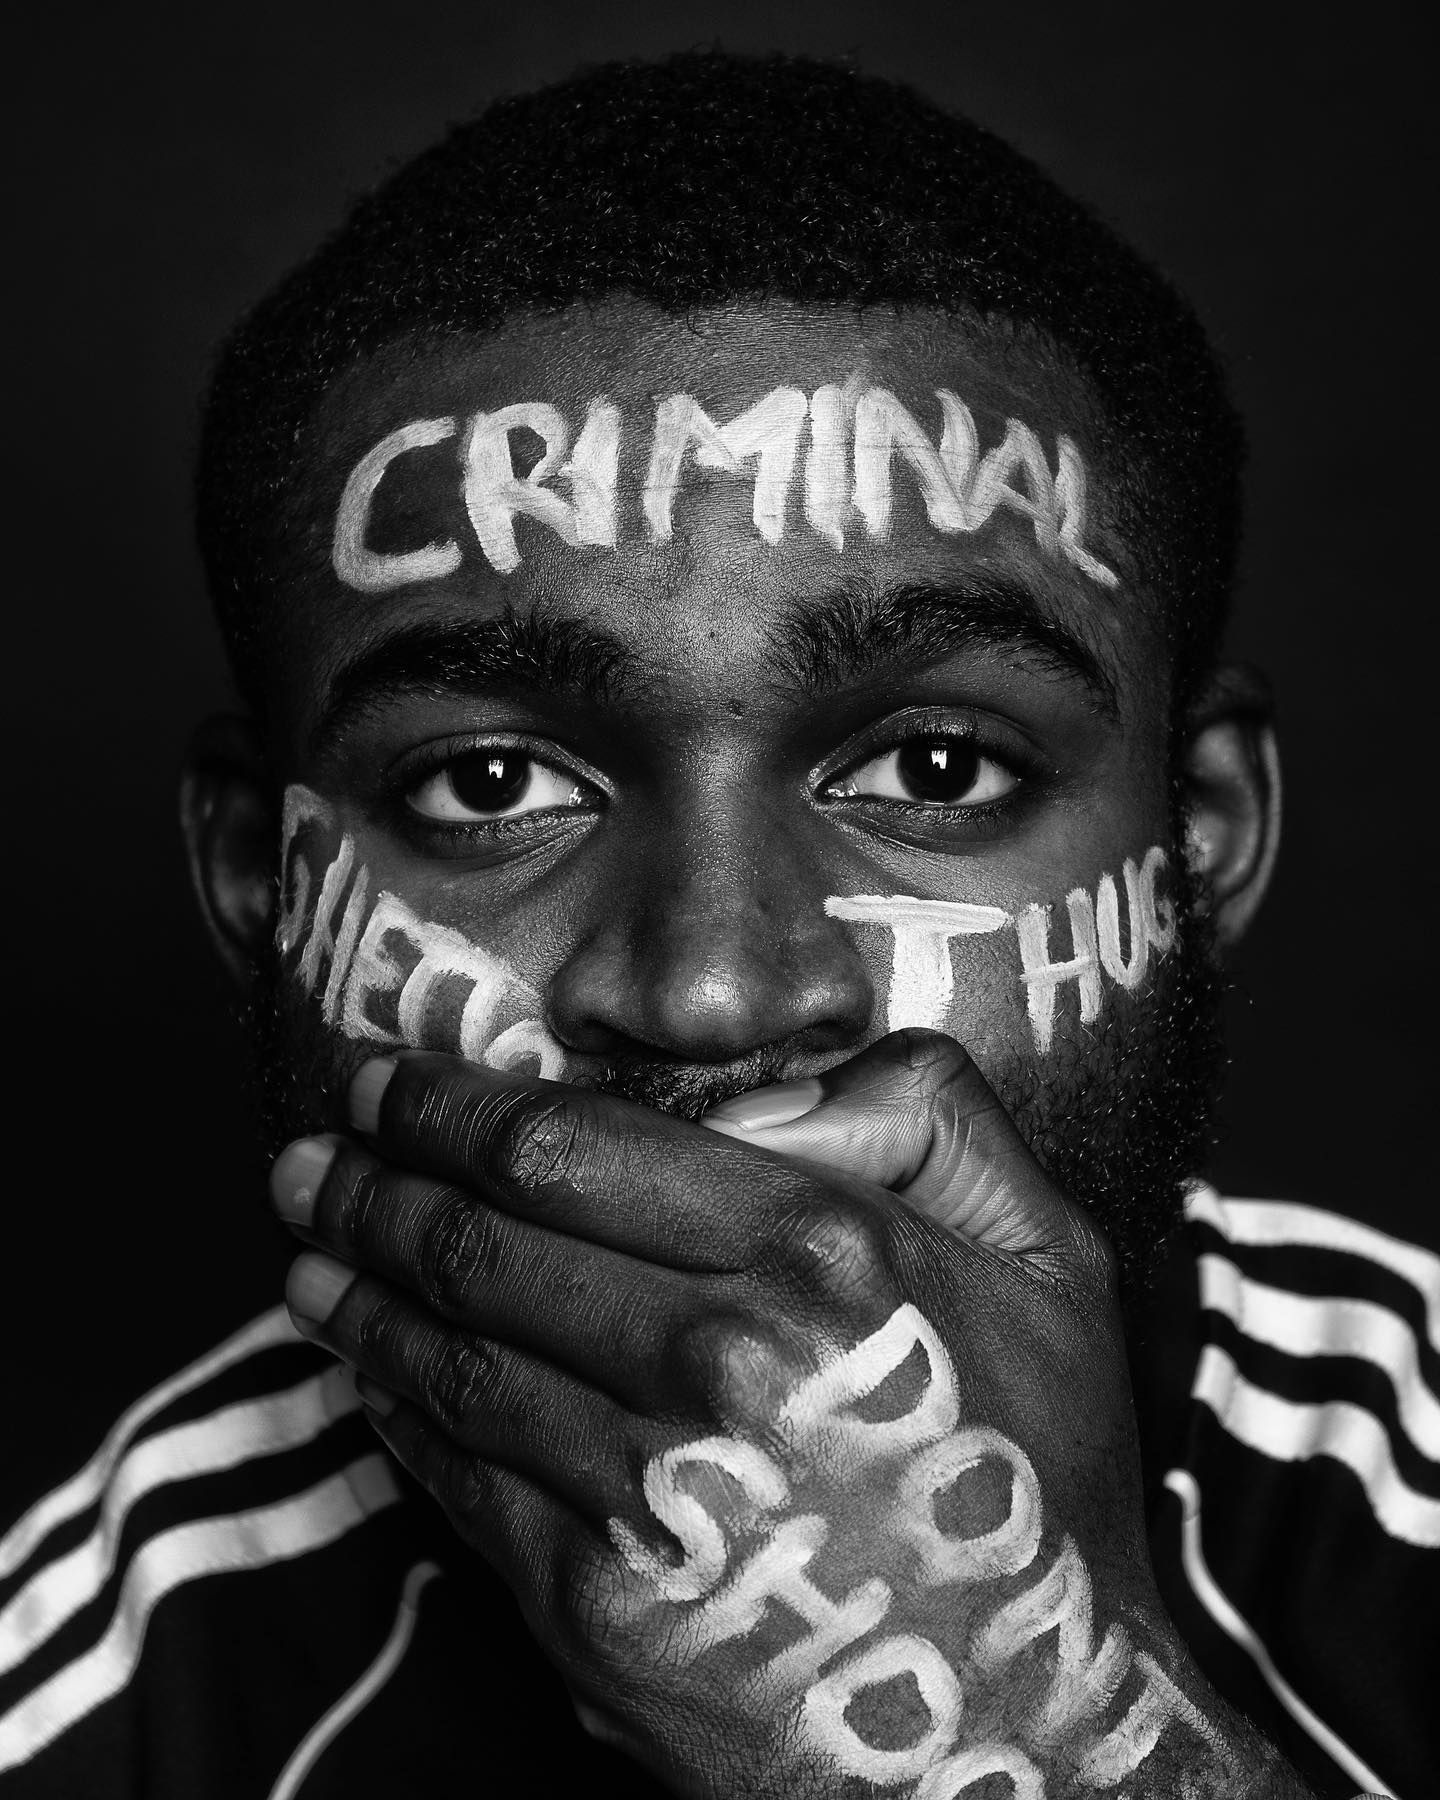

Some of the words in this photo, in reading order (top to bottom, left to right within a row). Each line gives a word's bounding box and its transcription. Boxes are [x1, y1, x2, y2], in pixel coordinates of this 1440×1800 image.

[332, 374, 1119, 592] CRIMINAL
[823, 846, 1180, 1056] THUG
[776, 1302, 1236, 1788] DONT
